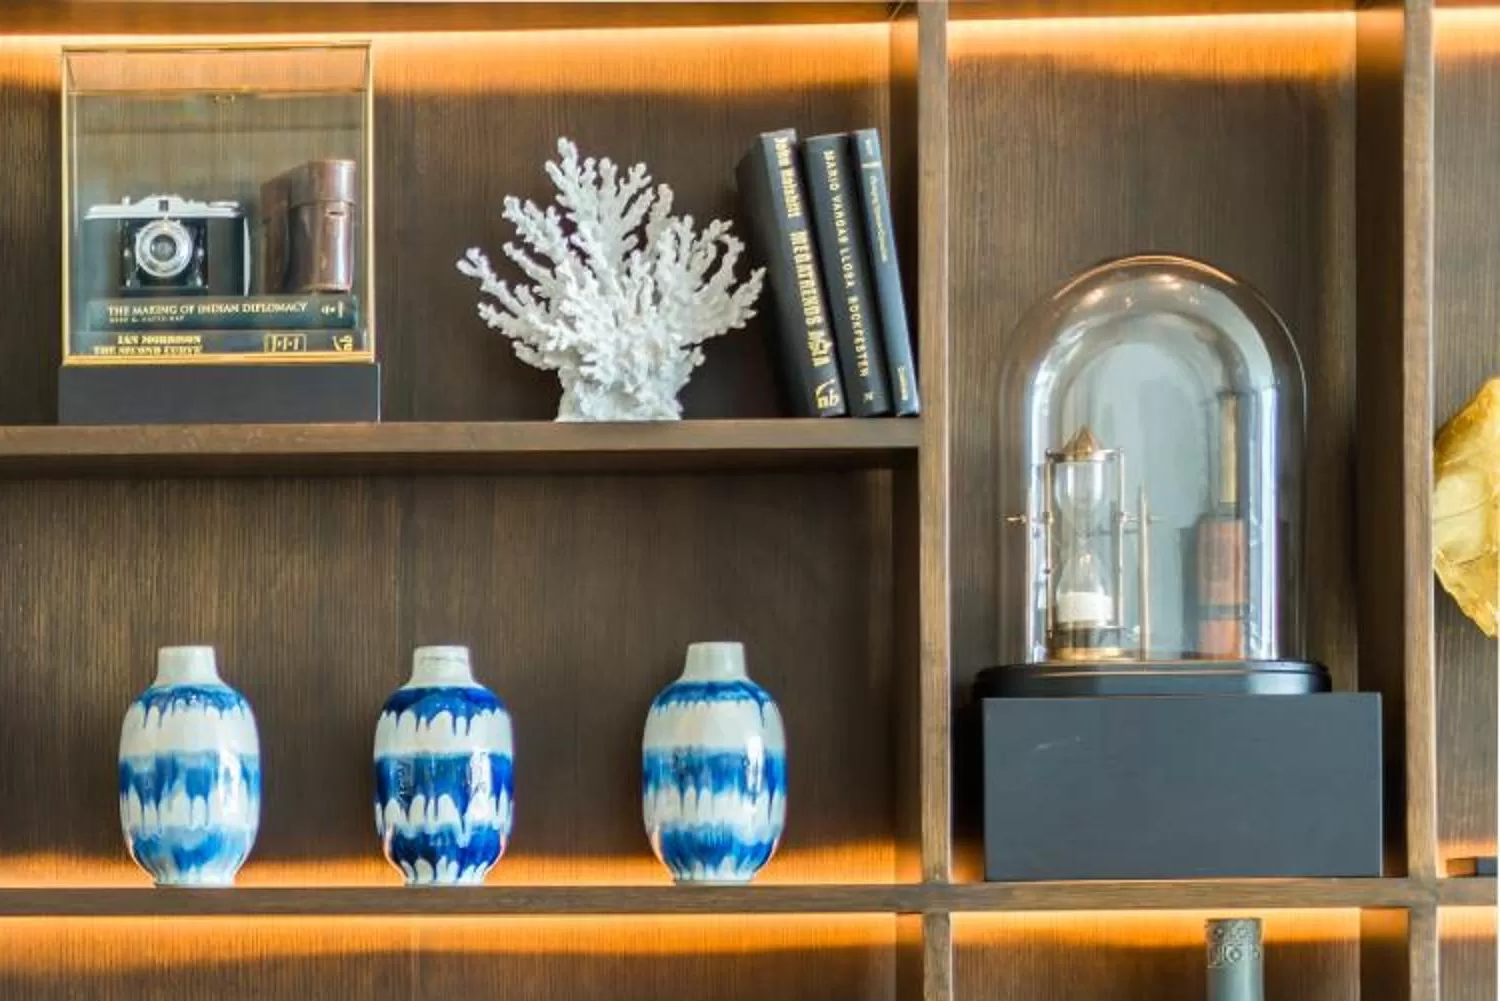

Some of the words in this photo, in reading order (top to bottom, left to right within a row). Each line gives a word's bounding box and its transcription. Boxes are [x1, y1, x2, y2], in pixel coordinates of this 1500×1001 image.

[823, 150, 840, 191] MARIO
[831, 193, 850, 249] VARGAS
[790, 231, 825, 325] MEGATRENDS
[840, 249, 856, 288] LLOSA
[108, 305, 130, 316] THE
[132, 303, 177, 315] MAKING
[179, 303, 195, 315] OF
